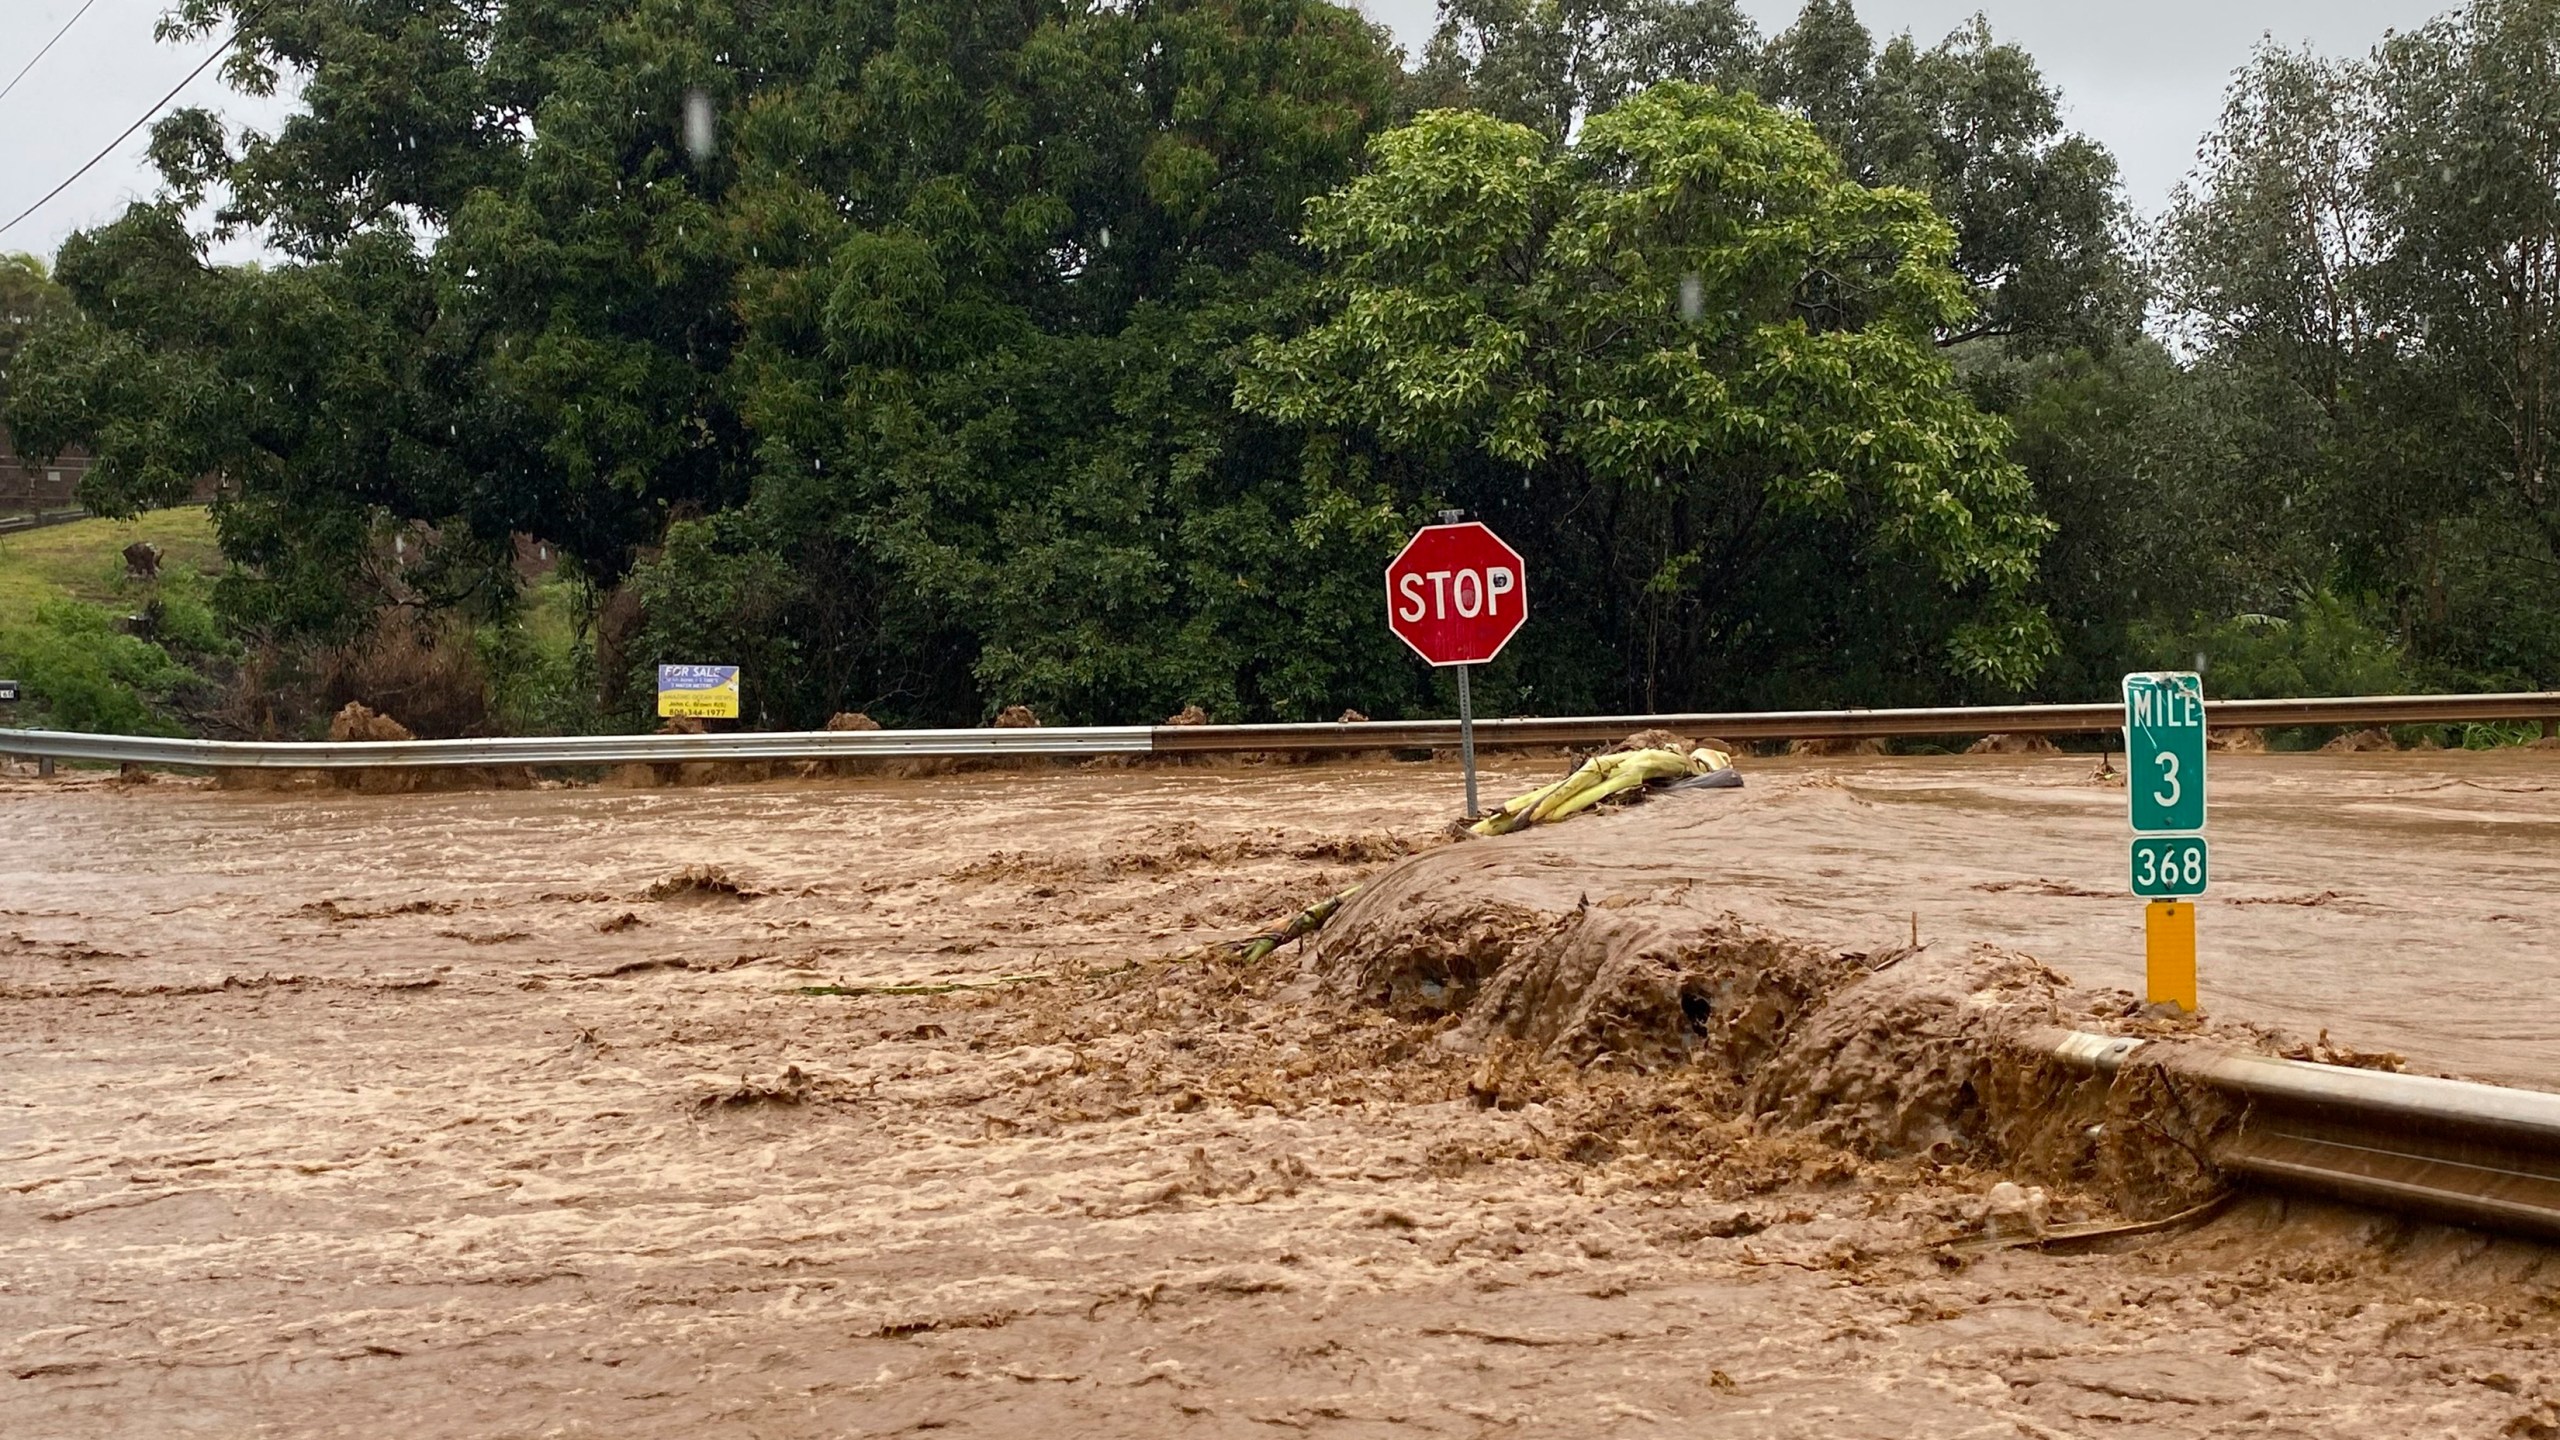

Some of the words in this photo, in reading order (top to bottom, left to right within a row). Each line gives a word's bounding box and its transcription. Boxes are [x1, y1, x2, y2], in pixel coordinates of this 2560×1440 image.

[1399, 566, 1515, 623] STOP
[664, 666, 689, 677] FOR
[693, 667, 721, 678] SALE
[2133, 688, 2199, 728] MILE
[2153, 750, 2181, 807] 3
[2137, 847, 2202, 887] 368
